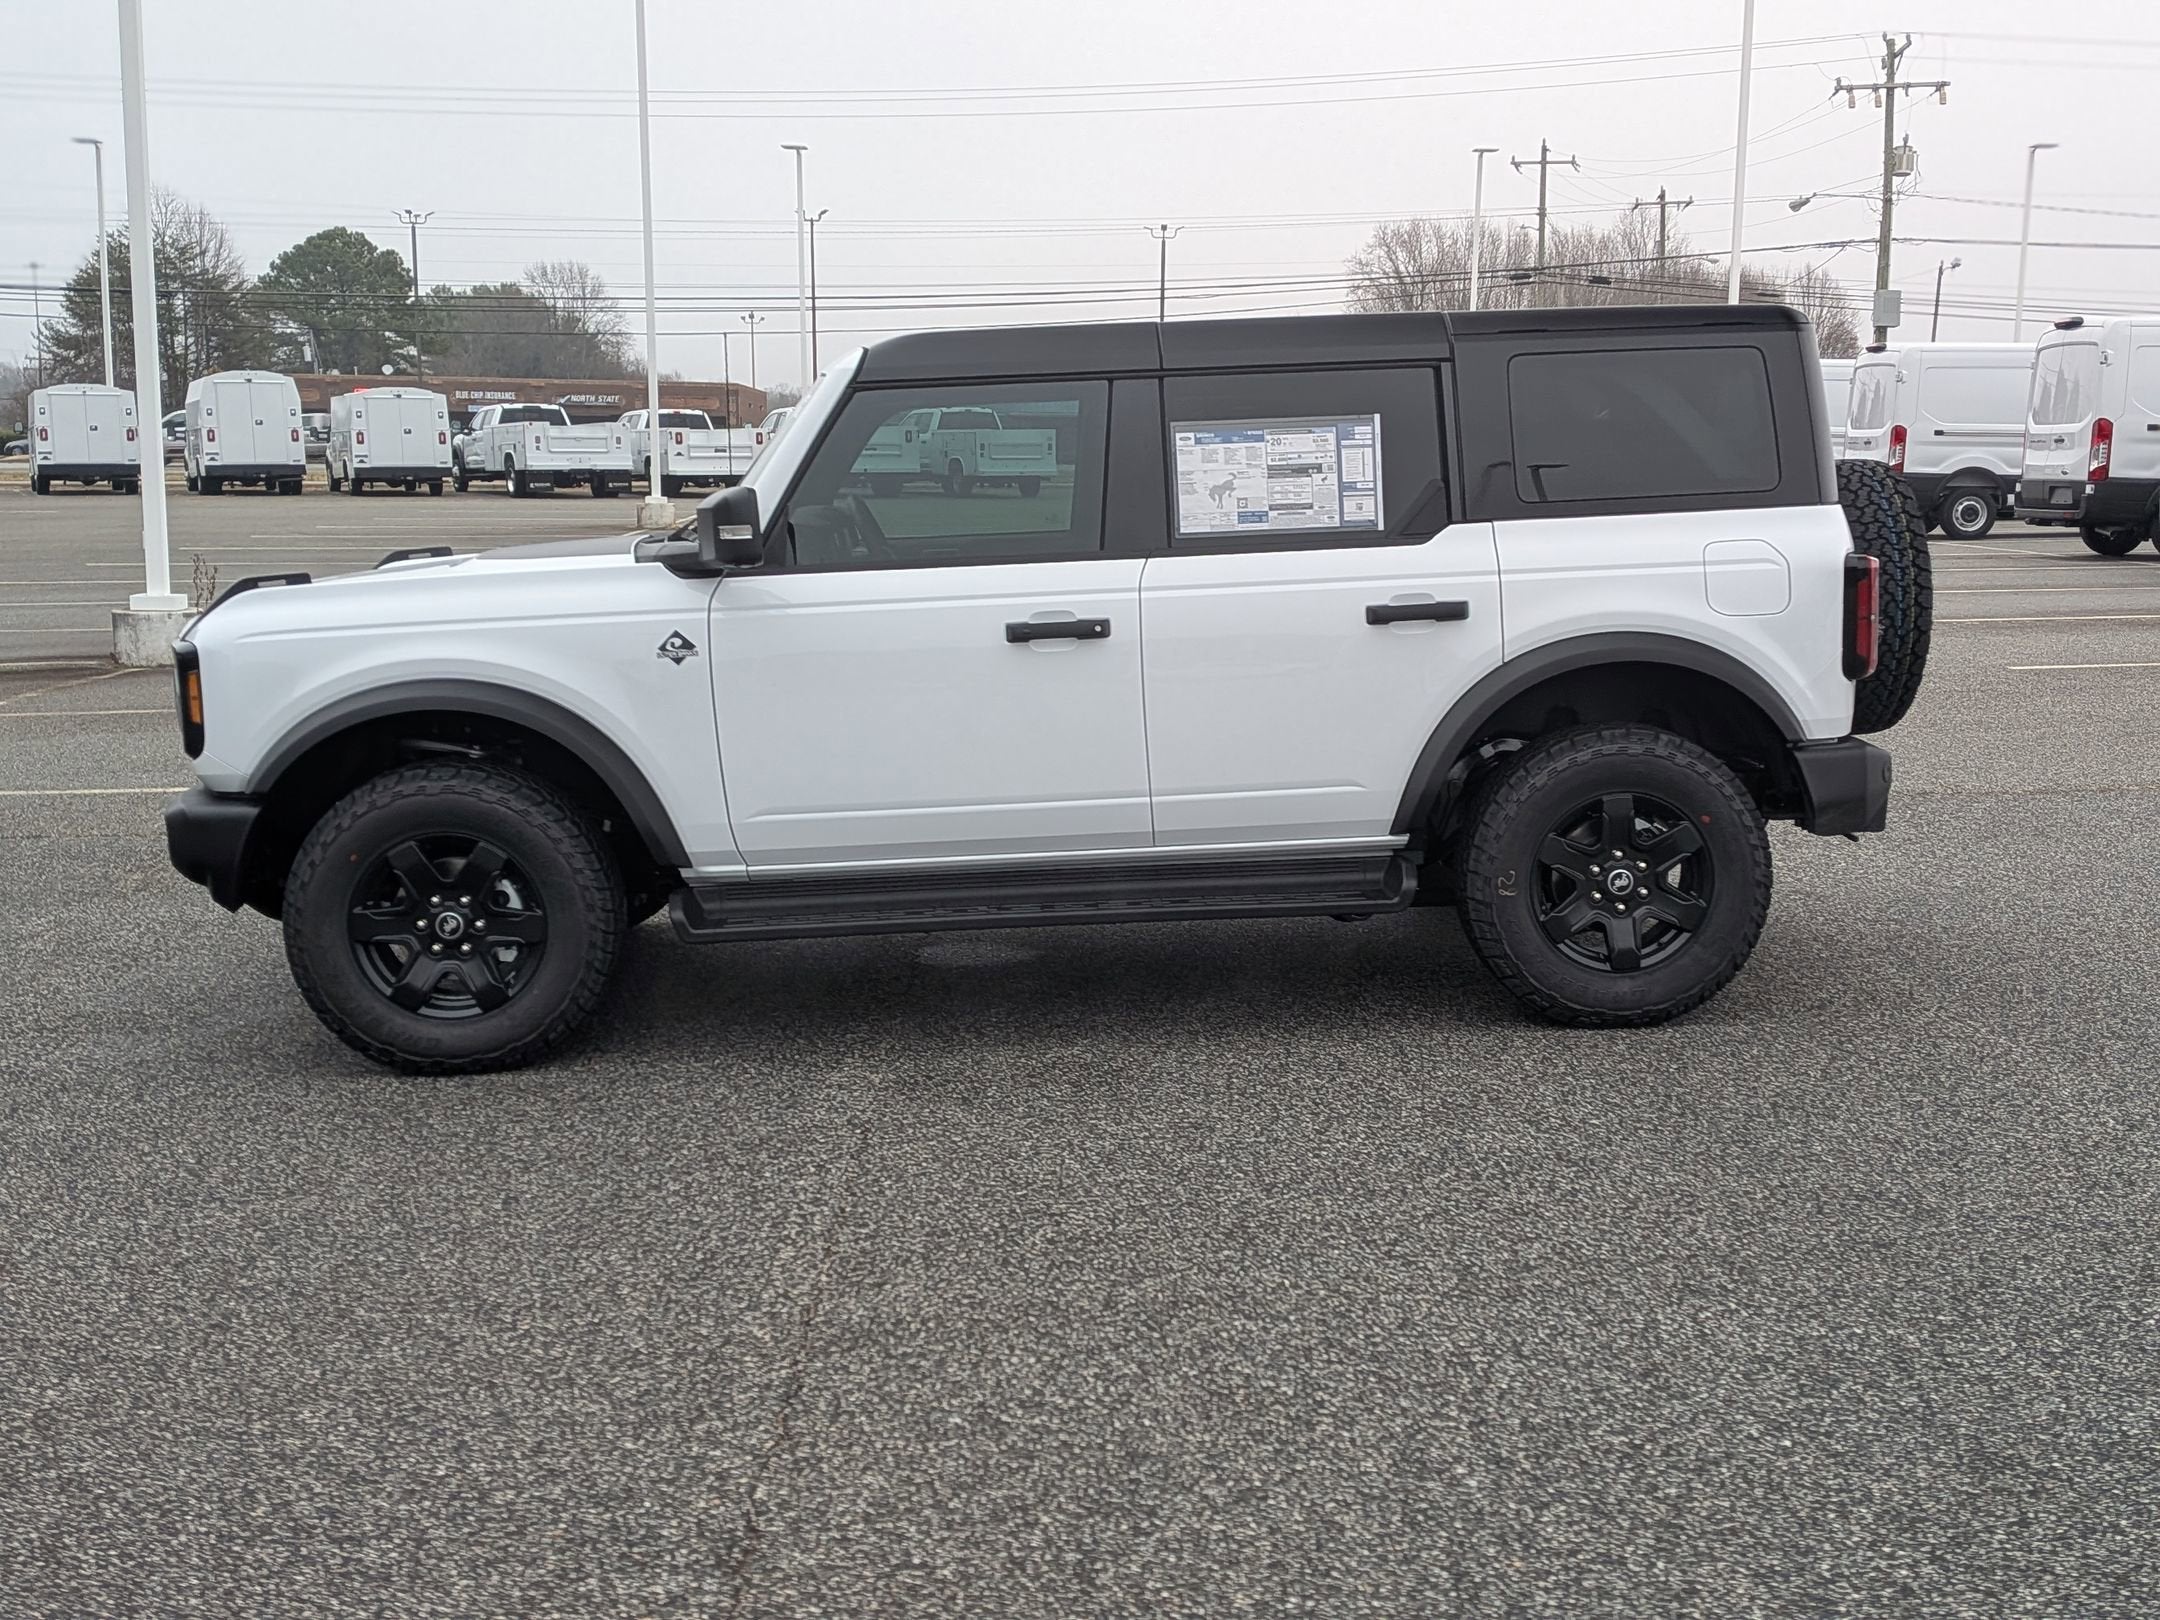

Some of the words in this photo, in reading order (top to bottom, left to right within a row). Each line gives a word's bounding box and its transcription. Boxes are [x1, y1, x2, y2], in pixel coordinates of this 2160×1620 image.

[455, 390, 469, 399] BLUE
[471, 391, 484, 399] CHIP
[485, 391, 516, 400] INSURANCE
[571, 394, 596, 402] NORTH
[597, 395, 620, 403] STATE
[1270, 437, 1282, 446] 20
